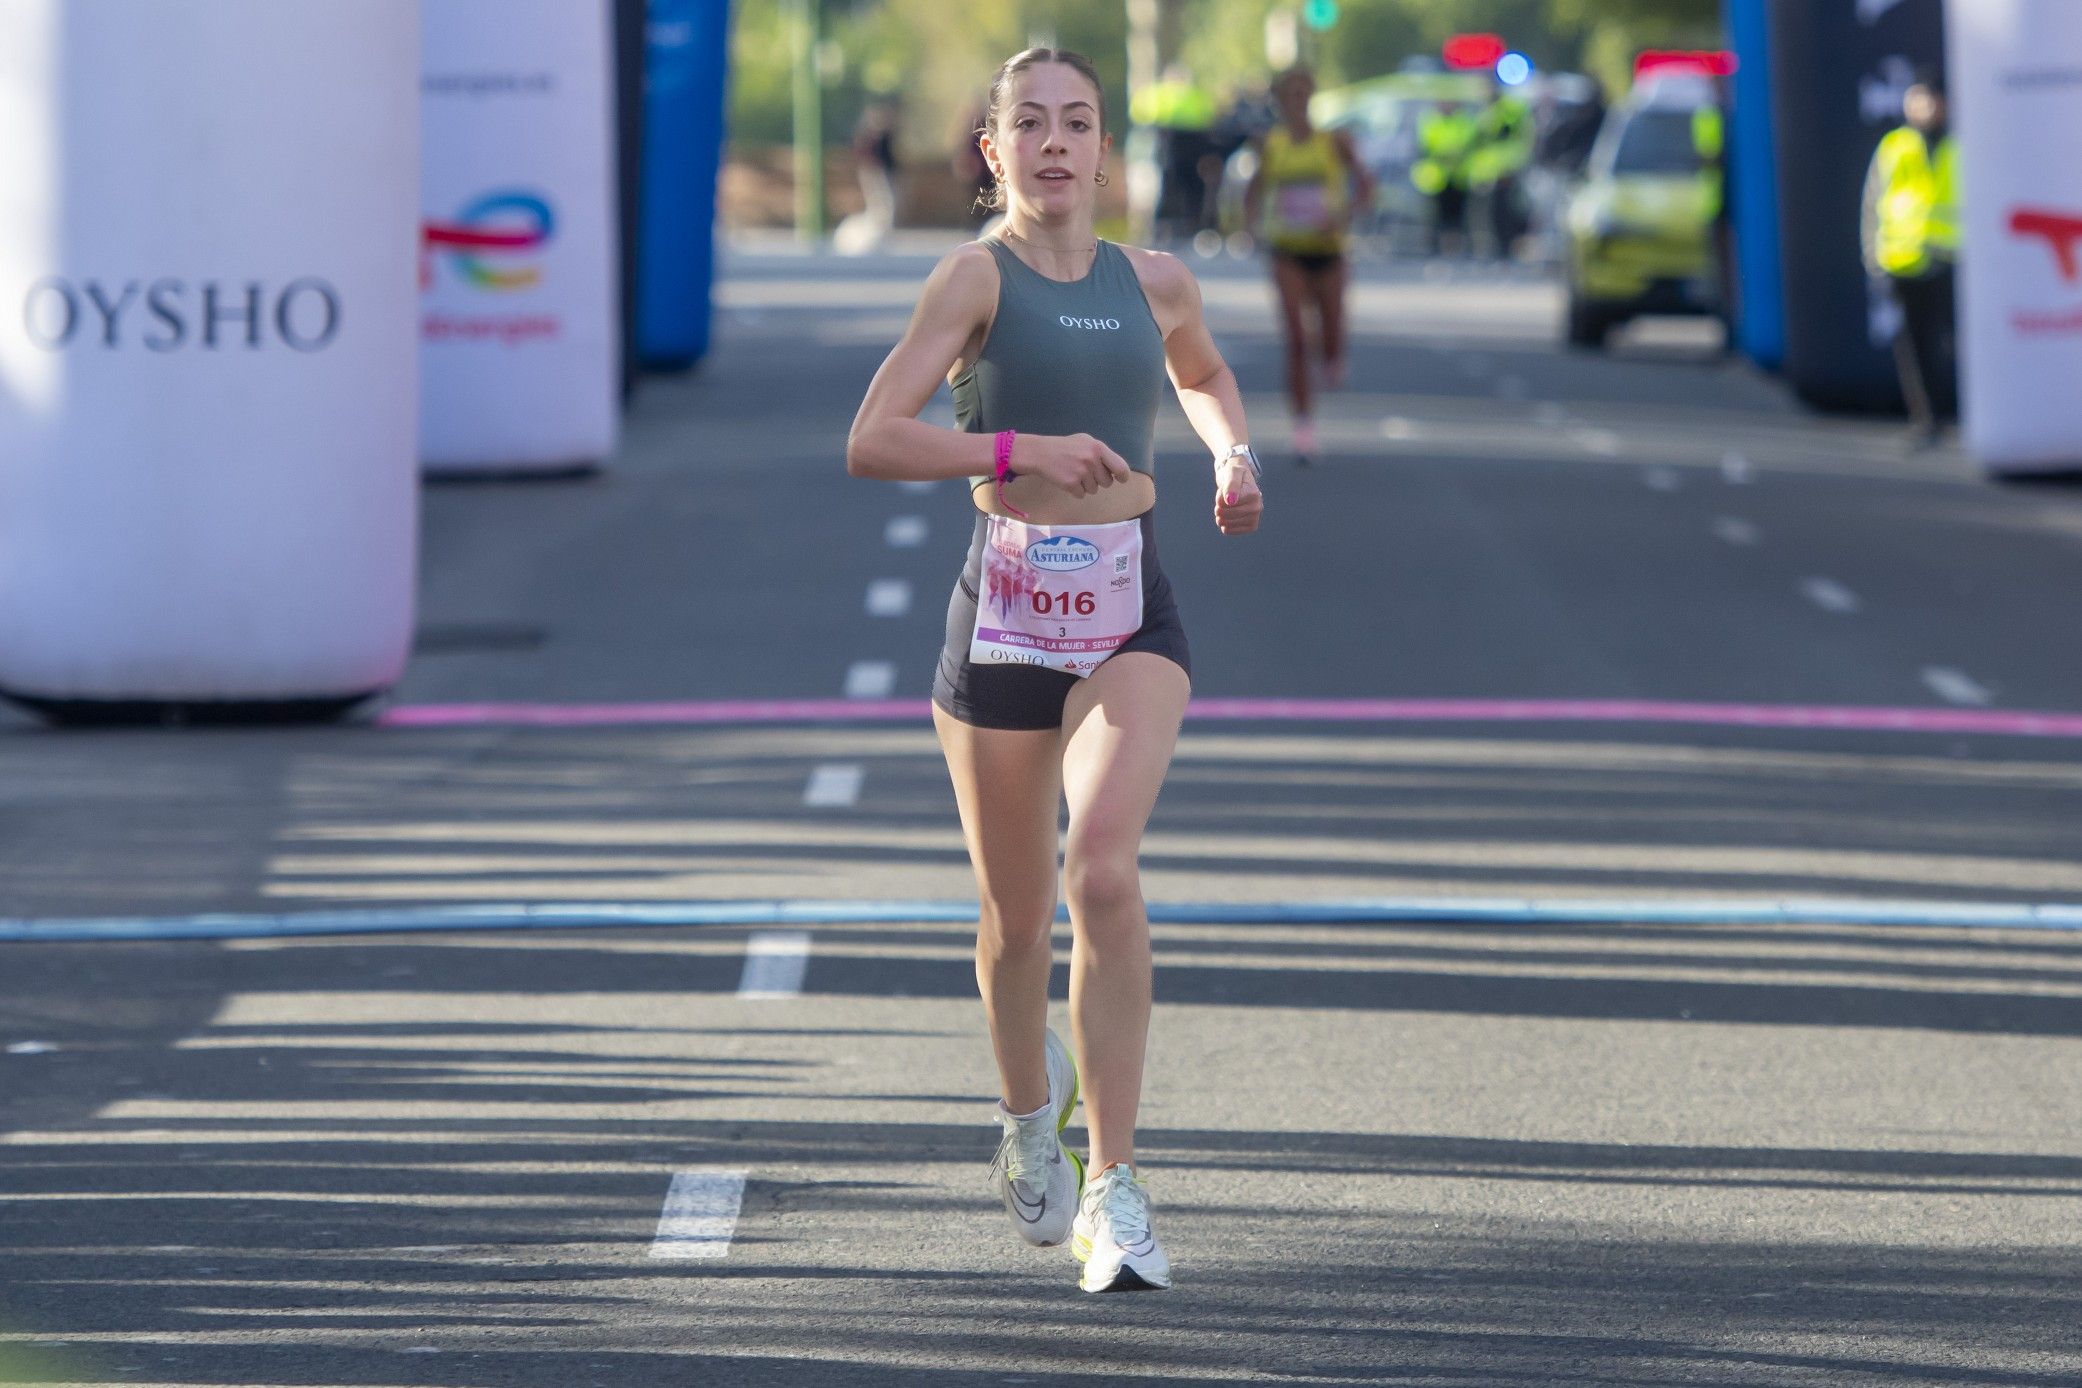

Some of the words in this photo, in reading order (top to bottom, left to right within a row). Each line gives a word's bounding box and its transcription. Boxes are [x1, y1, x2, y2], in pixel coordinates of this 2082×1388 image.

[24, 275, 342, 353] OYSHO
[1060, 315, 1120, 330] OYSHO
[997, 545, 1022, 558] SUMA
[1032, 591, 1096, 616] 016
[1058, 626, 1066, 638] 3
[1000, 633, 1035, 646] CARRERA
[1036, 639, 1046, 648] DE
[1047, 641, 1057, 650] LA
[1058, 641, 1086, 650] MUJER
[1092, 638, 1120, 650] SEVILLA
[991, 649, 1044, 666] OYSHO
